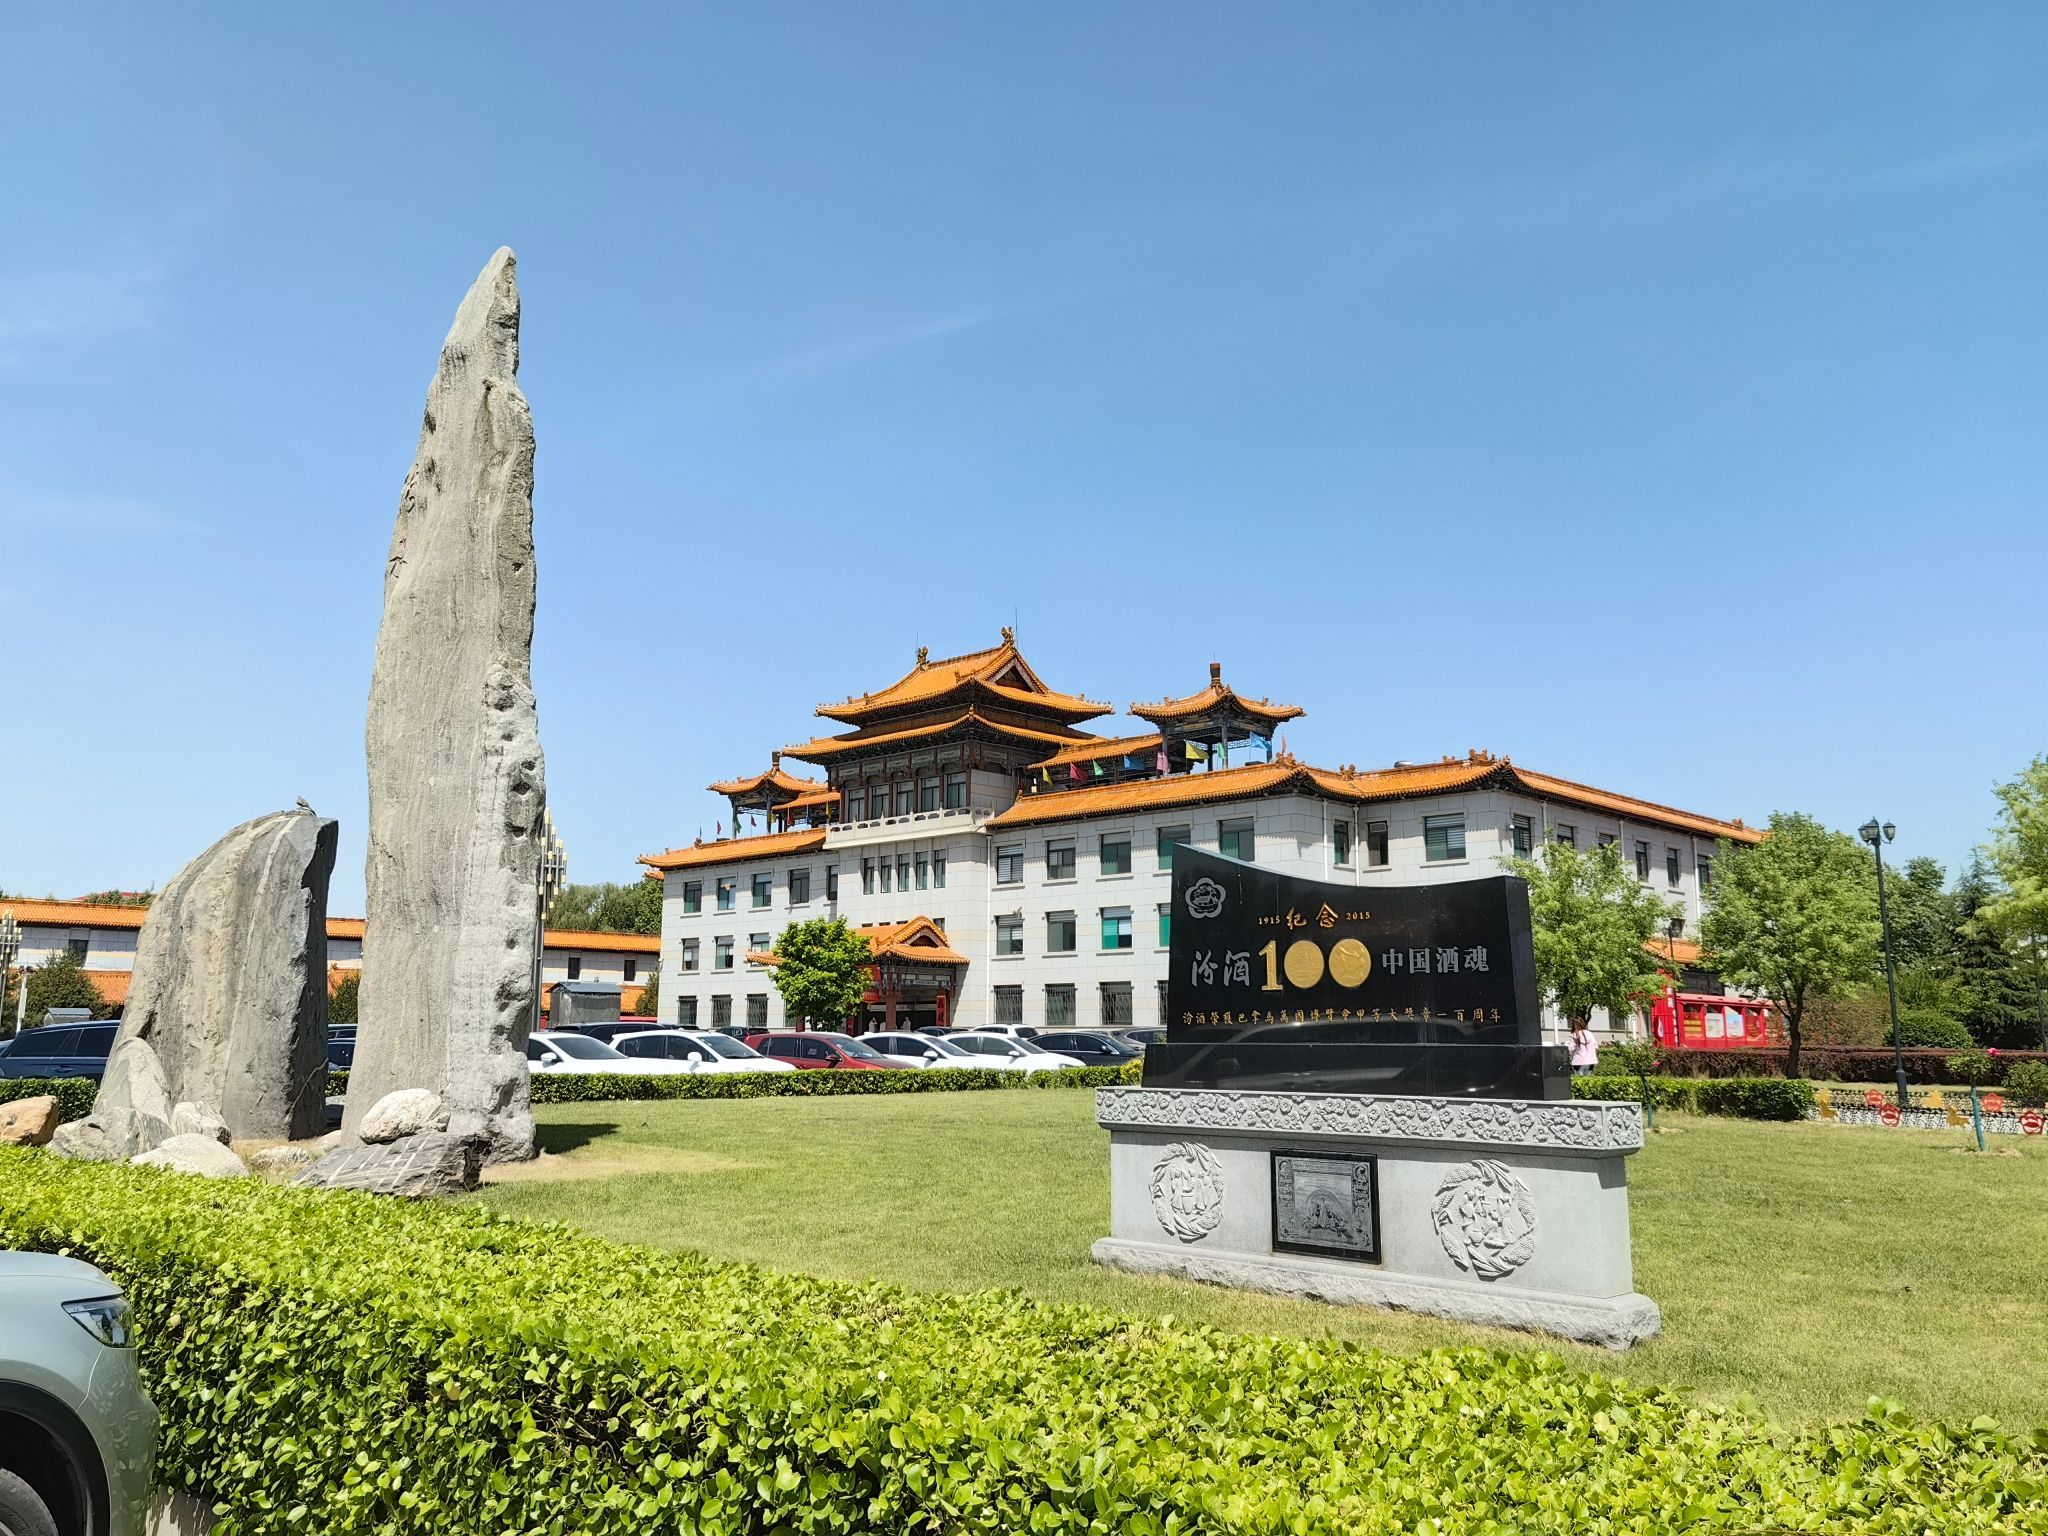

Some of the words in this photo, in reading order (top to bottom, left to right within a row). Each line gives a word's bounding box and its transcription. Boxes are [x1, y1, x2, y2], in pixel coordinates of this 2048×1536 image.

[1258, 915, 1281, 925] 1915
[1345, 911, 1371, 920] 2015
[1191, 949, 1250, 987] 汾酒
[1382, 945, 1490, 975] 中国酒魂
